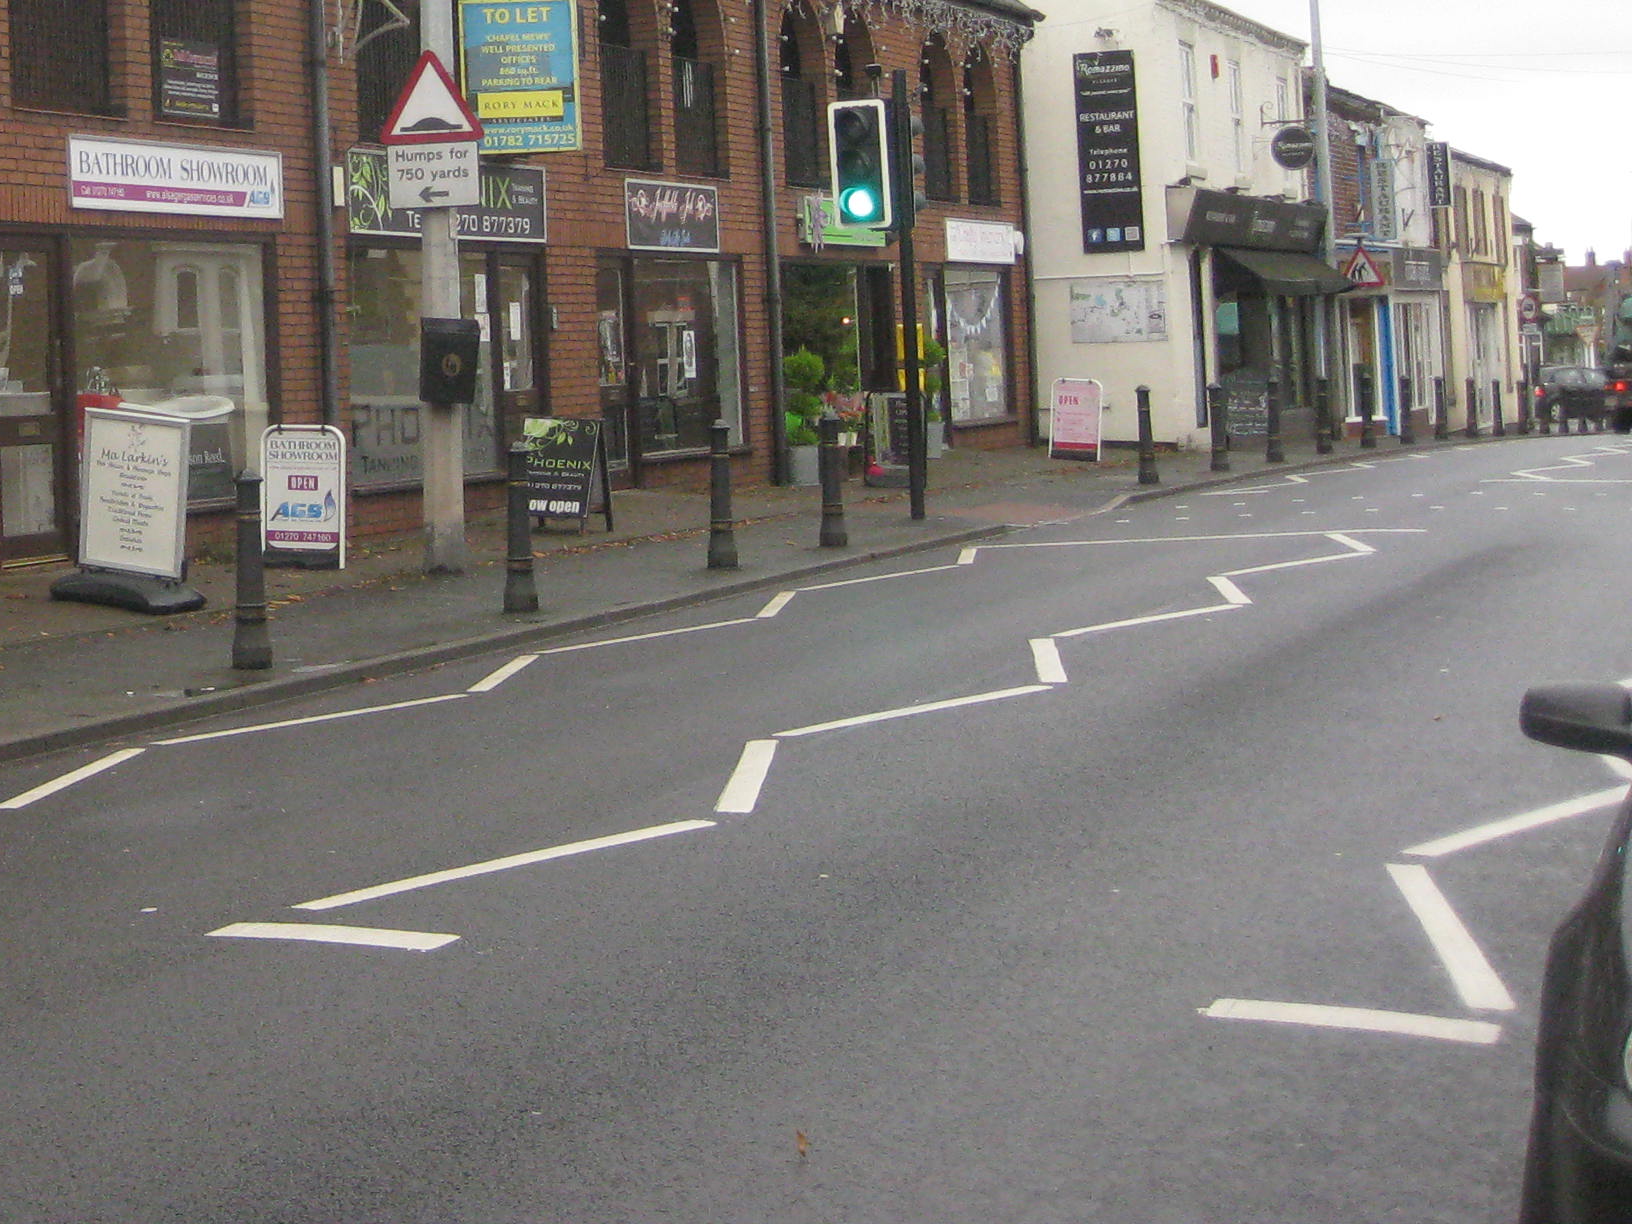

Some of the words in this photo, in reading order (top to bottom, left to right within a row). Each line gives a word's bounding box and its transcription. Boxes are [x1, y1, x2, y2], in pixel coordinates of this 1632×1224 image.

[483, 8, 510, 24] TO
[515, 7, 551, 23] LET
[484, 102, 517, 111] RORY
[524, 100, 560, 109] MACK
[1080, 110, 1135, 122] RESTAURANT
[1102, 124, 1121, 133] BAR
[484, 135, 524, 147] 01782
[528, 133, 575, 146] 715725
[395, 149, 443, 163] Humps
[449, 147, 468, 160] for
[1089, 148, 1128, 156] Telephone
[79, 150, 172, 179] BATHROOM
[180, 159, 268, 186] SHOWROOM
[1089, 158, 1128, 170] 01270
[397, 167, 425, 181] 750
[430, 166, 470, 181] yards
[482, 216, 531, 235] 877379
[270, 439, 336, 451] BATHROOM
[101, 448, 118, 461] Ma
[122, 451, 168, 467] Larkin's
[269, 450, 337, 462] SHOWROOM
[527, 456, 591, 470] PHOENIX
[290, 476, 316, 489] OPEN
[529, 499, 548, 512] ow
[549, 500, 580, 514] open
[274, 531, 299, 541] 01270
